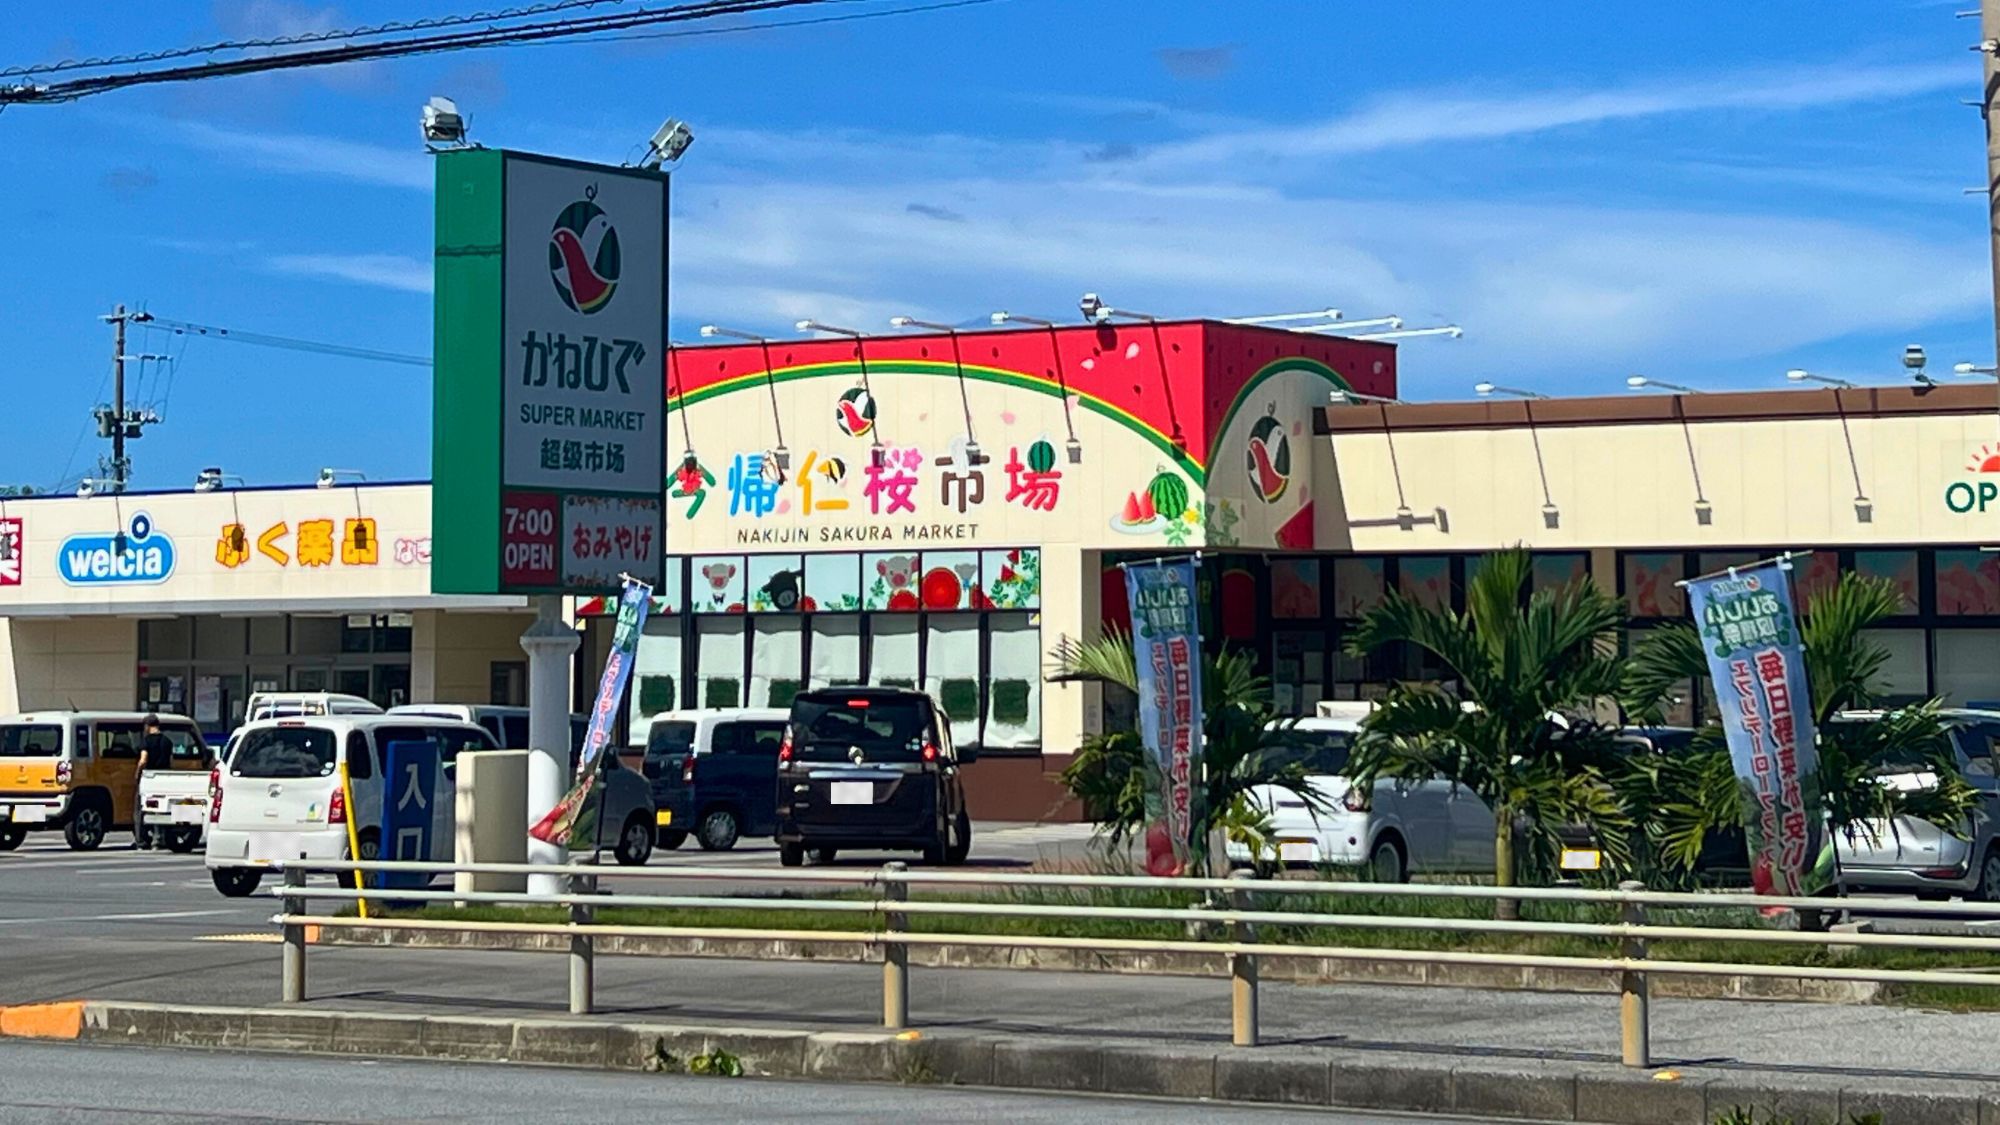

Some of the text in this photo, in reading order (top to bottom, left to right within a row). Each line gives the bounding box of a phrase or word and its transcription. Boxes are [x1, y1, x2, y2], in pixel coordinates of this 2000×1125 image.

[521, 330, 646, 394] かねひで
[520, 403, 646, 432] SUPER MARKET
[540, 437, 625, 473] 超级市场
[666, 445, 1063, 519] 今帰仁桜市場
[505, 508, 553, 536] 7:00
[572, 521, 653, 562] おみやげ
[736, 523, 980, 545] NAKIJIN SAKURA MARKET
[67, 514, 163, 578] welcia
[214, 518, 379, 568] ふく薬品
[504, 542, 553, 570] OPEN
[397, 763, 427, 861] 入口
